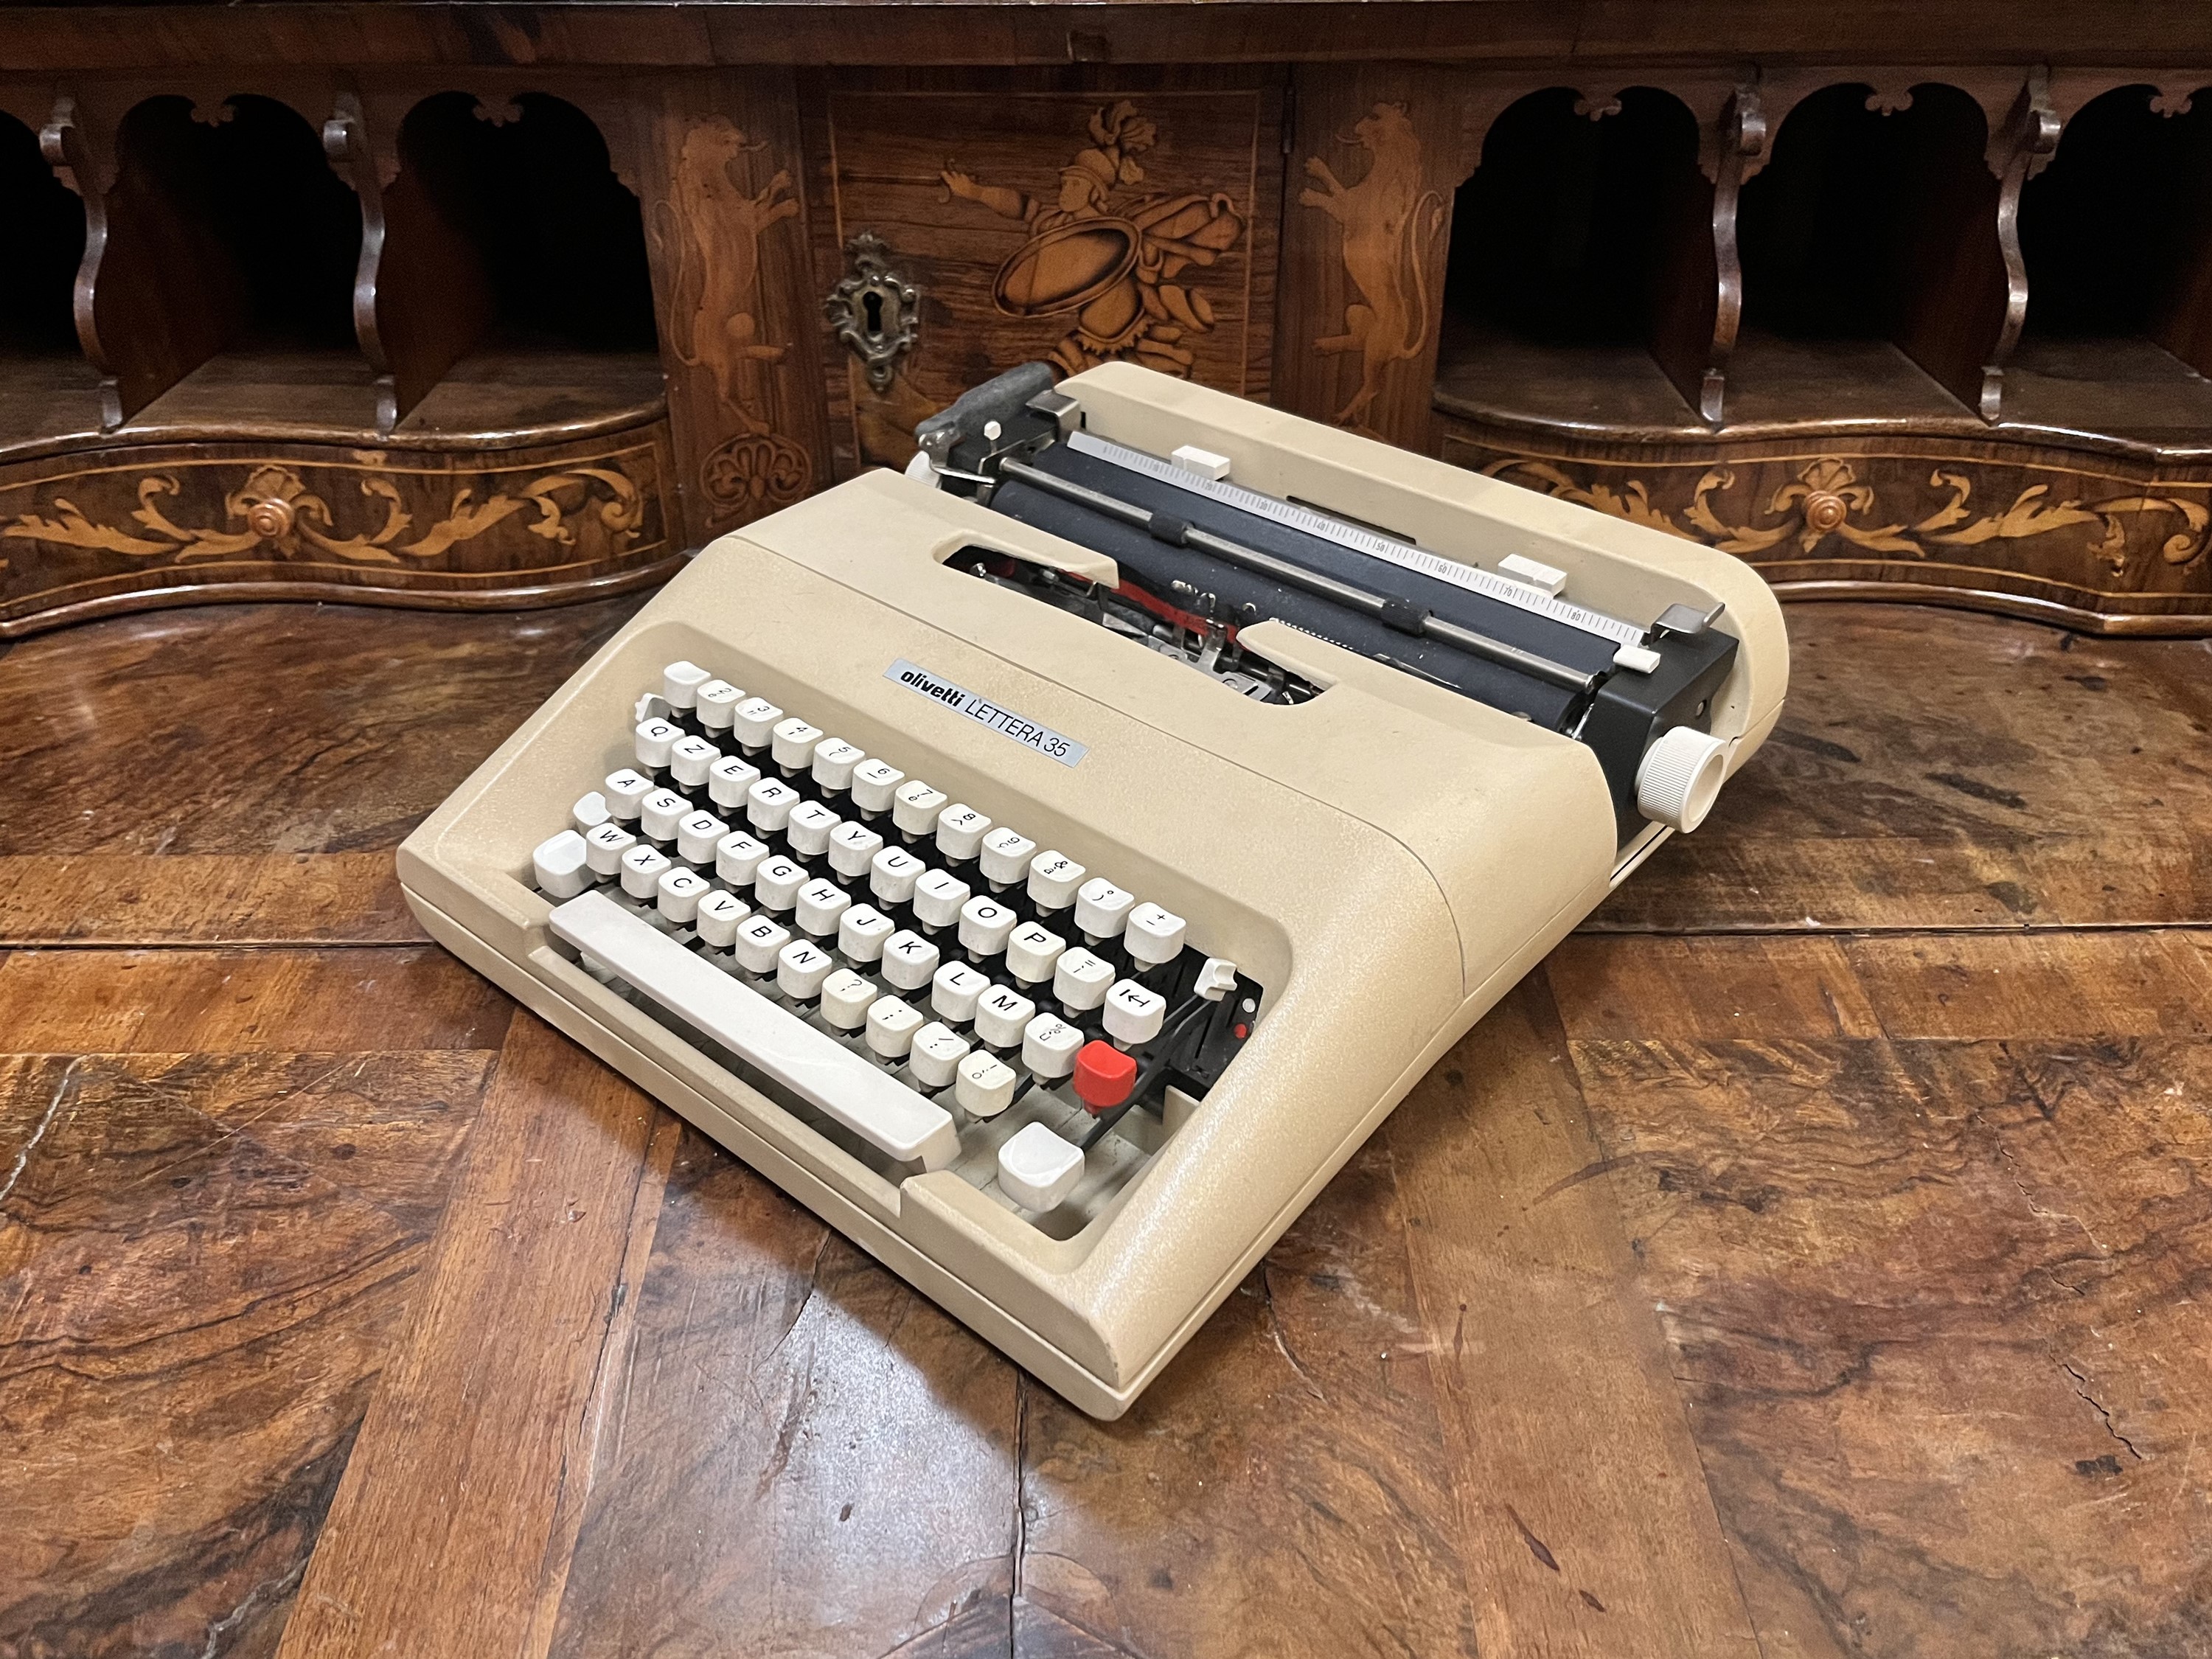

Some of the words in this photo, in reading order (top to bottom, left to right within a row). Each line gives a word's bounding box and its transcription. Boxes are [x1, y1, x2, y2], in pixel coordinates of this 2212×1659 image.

[1376, 543, 1385, 552] 50
[1439, 563, 1447, 574] 60
[1504, 587, 1513, 597] 70
[1571, 611, 1581, 621] 80
[900, 669, 967, 708] olivetti
[964, 698, 1045, 748] LETTERA
[1043, 737, 1071, 757] 35
[650, 726, 669, 737] Q
[684, 744, 705, 754] Z
[723, 765, 744, 775] E
[617, 779, 636, 787] A
[761, 787, 782, 798] R
[656, 798, 676, 807] S
[807, 809, 826, 819] T
[962, 813, 976, 821] 8
[692, 819, 712, 830] D
[599, 830, 619, 843] W
[847, 830, 866, 841] Y
[731, 841, 752, 849] F
[633, 855, 655, 866] X
[887, 856, 908, 868] U
[1054, 860, 1068, 869] &
[772, 866, 793, 877] G
[673, 877, 692, 888] C
[933, 882, 950, 890] I
[811, 888, 835, 901] H
[714, 900, 734, 911] V
[977, 907, 998, 919] O
[856, 918, 877, 926] J
[751, 925, 773, 938] B
[1023, 932, 1047, 943] P
[898, 941, 922, 955] K
[792, 950, 816, 964] N
[847, 978, 863, 988] ?
[949, 972, 965, 986] L
[992, 995, 1018, 1012] M
[1050, 1023, 1067, 1034] %
